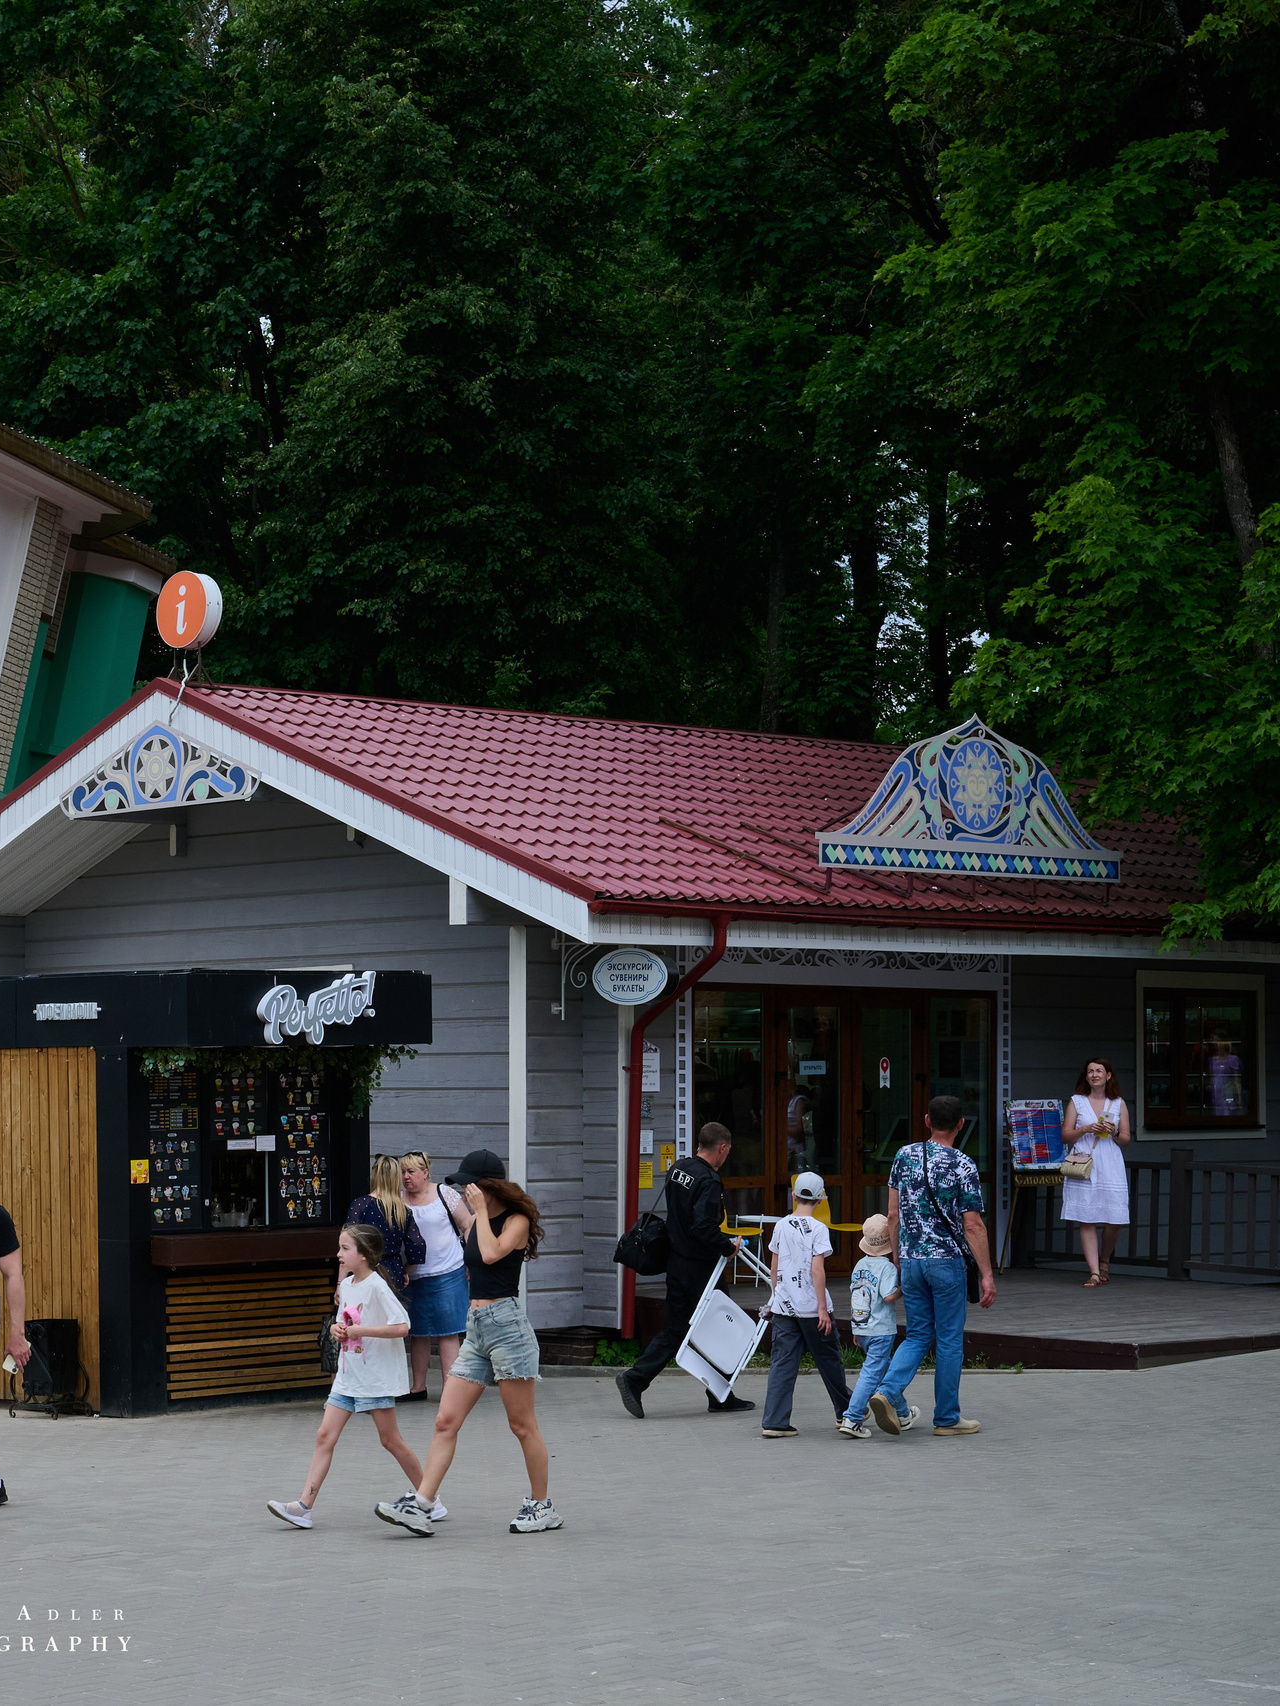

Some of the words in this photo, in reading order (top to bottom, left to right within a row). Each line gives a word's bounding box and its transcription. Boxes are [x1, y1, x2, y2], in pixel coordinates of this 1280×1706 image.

[175, 584, 187, 635] i
[607, 963, 653, 971] ЭКСКУРСИИ
[609, 973, 649, 982] СУВЕНИРЫ
[612, 984, 645, 992] БУКЛЕТЫ
[256, 970, 377, 1045] Perfetto!
[671, 1169, 691, 1186] ГБР
[1014, 1174, 1064, 1185] Смоленс
